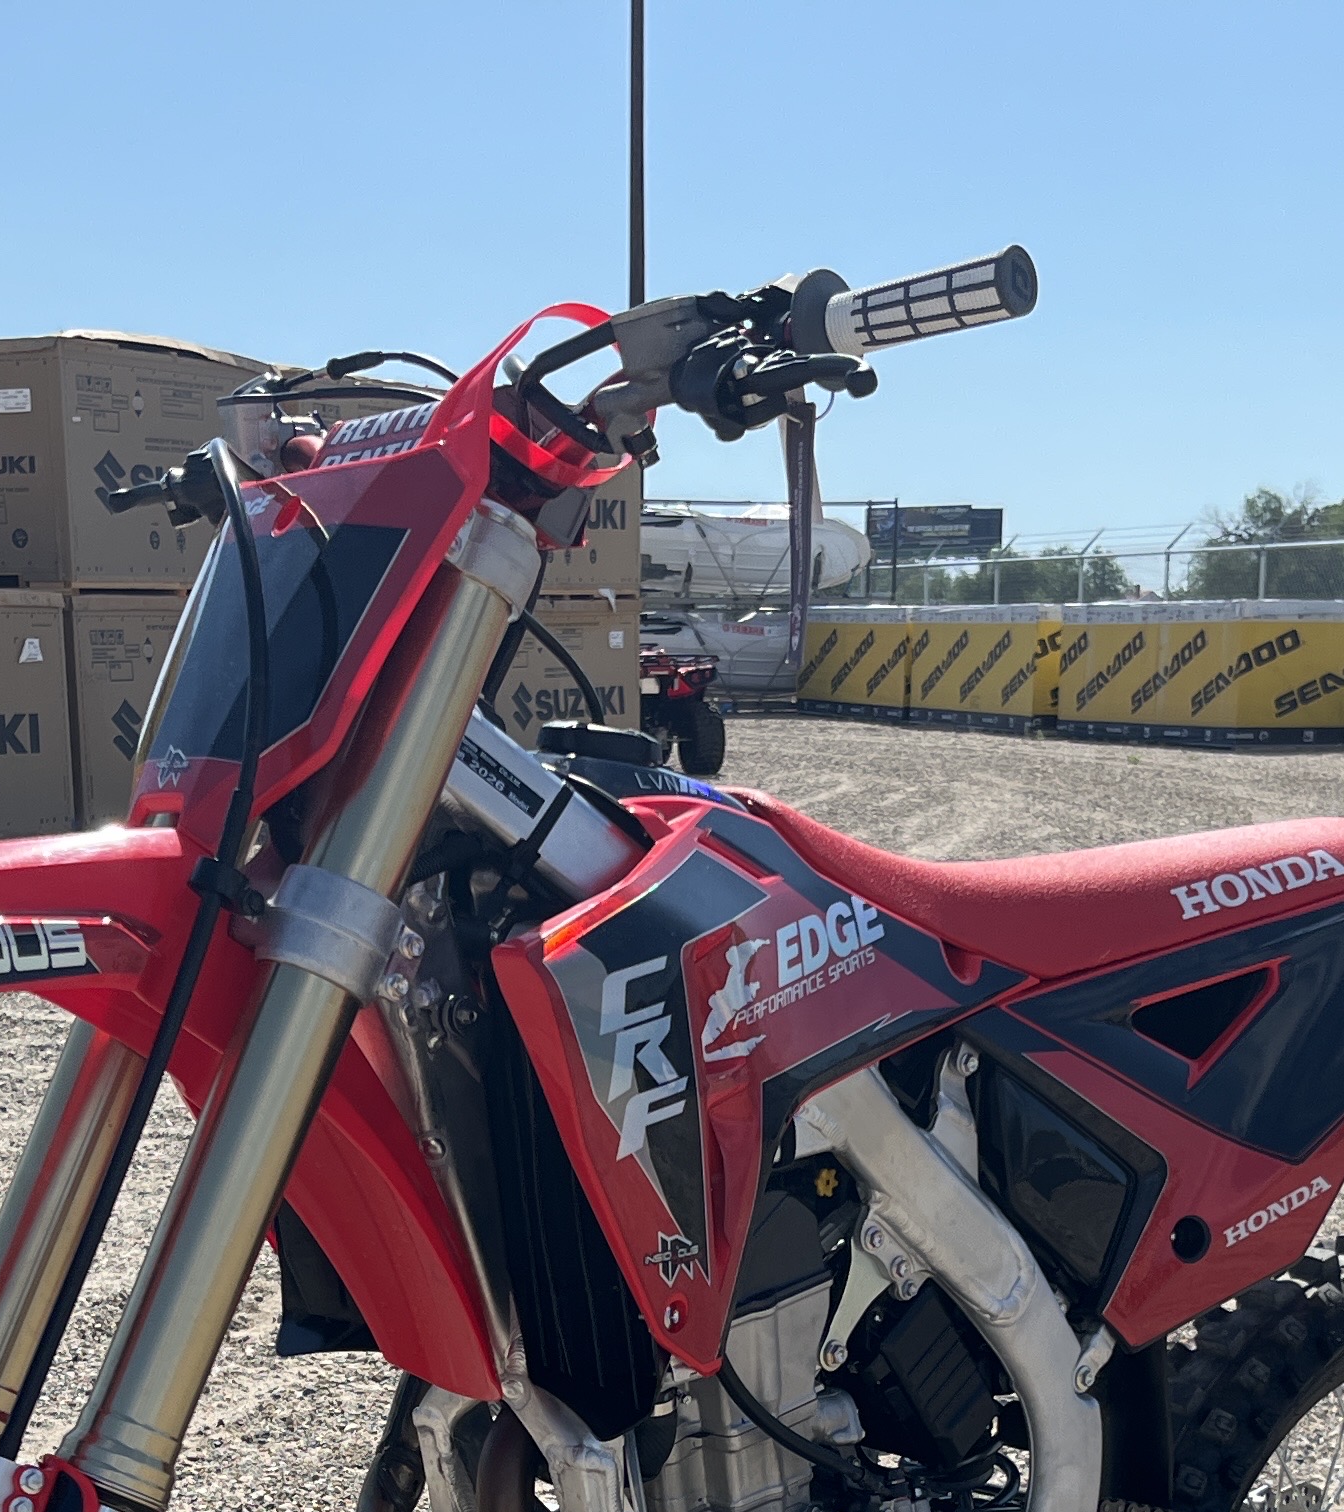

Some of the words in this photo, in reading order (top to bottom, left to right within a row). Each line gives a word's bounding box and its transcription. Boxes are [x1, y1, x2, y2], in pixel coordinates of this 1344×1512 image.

[470, 757, 505, 793] 2026
[777, 896, 885, 986] EDGE
[733, 975, 826, 1030] PERFORMANCE
[829, 947, 876, 983] SPORTS
[599, 956, 689, 1161] CRF
[1222, 1175, 1332, 1248] HONDA
